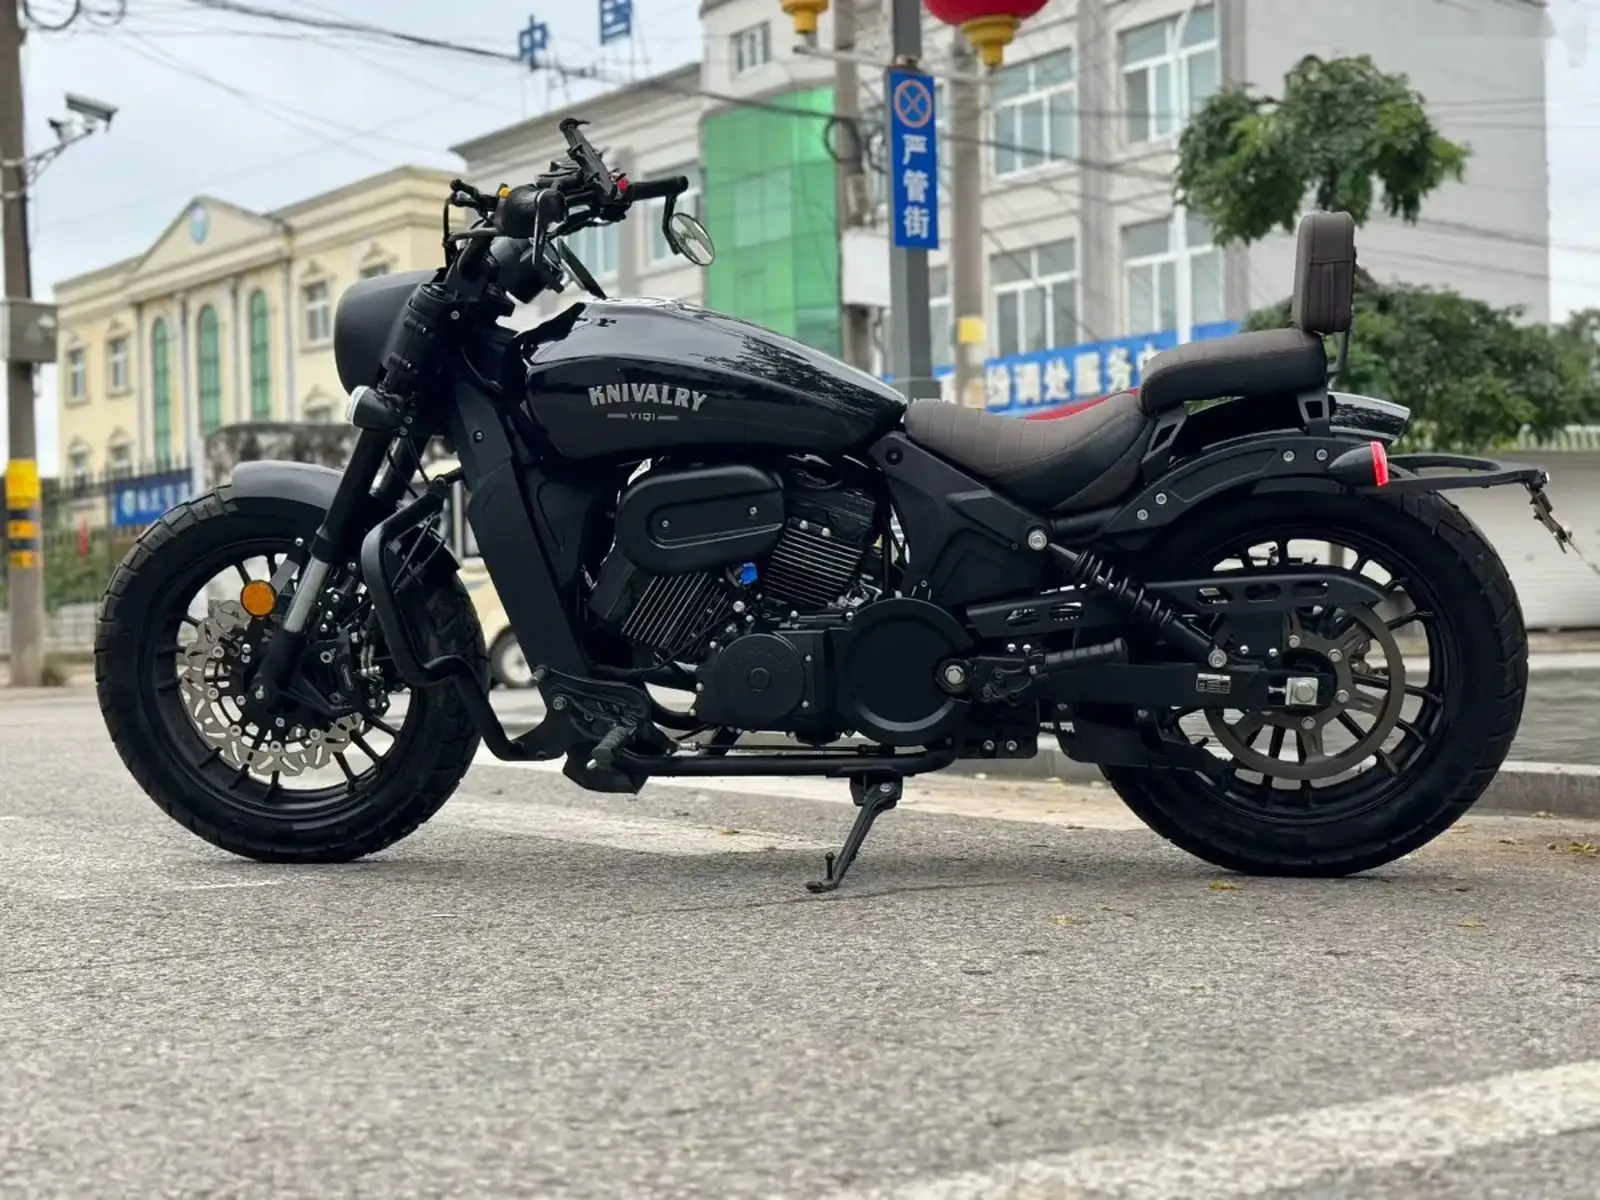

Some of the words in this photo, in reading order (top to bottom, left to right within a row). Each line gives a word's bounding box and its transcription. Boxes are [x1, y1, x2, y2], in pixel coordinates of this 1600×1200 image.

[902, 133, 930, 239] 严管街
[588, 383, 707, 411] KNIVALRY
[629, 412, 656, 421] YIQI
